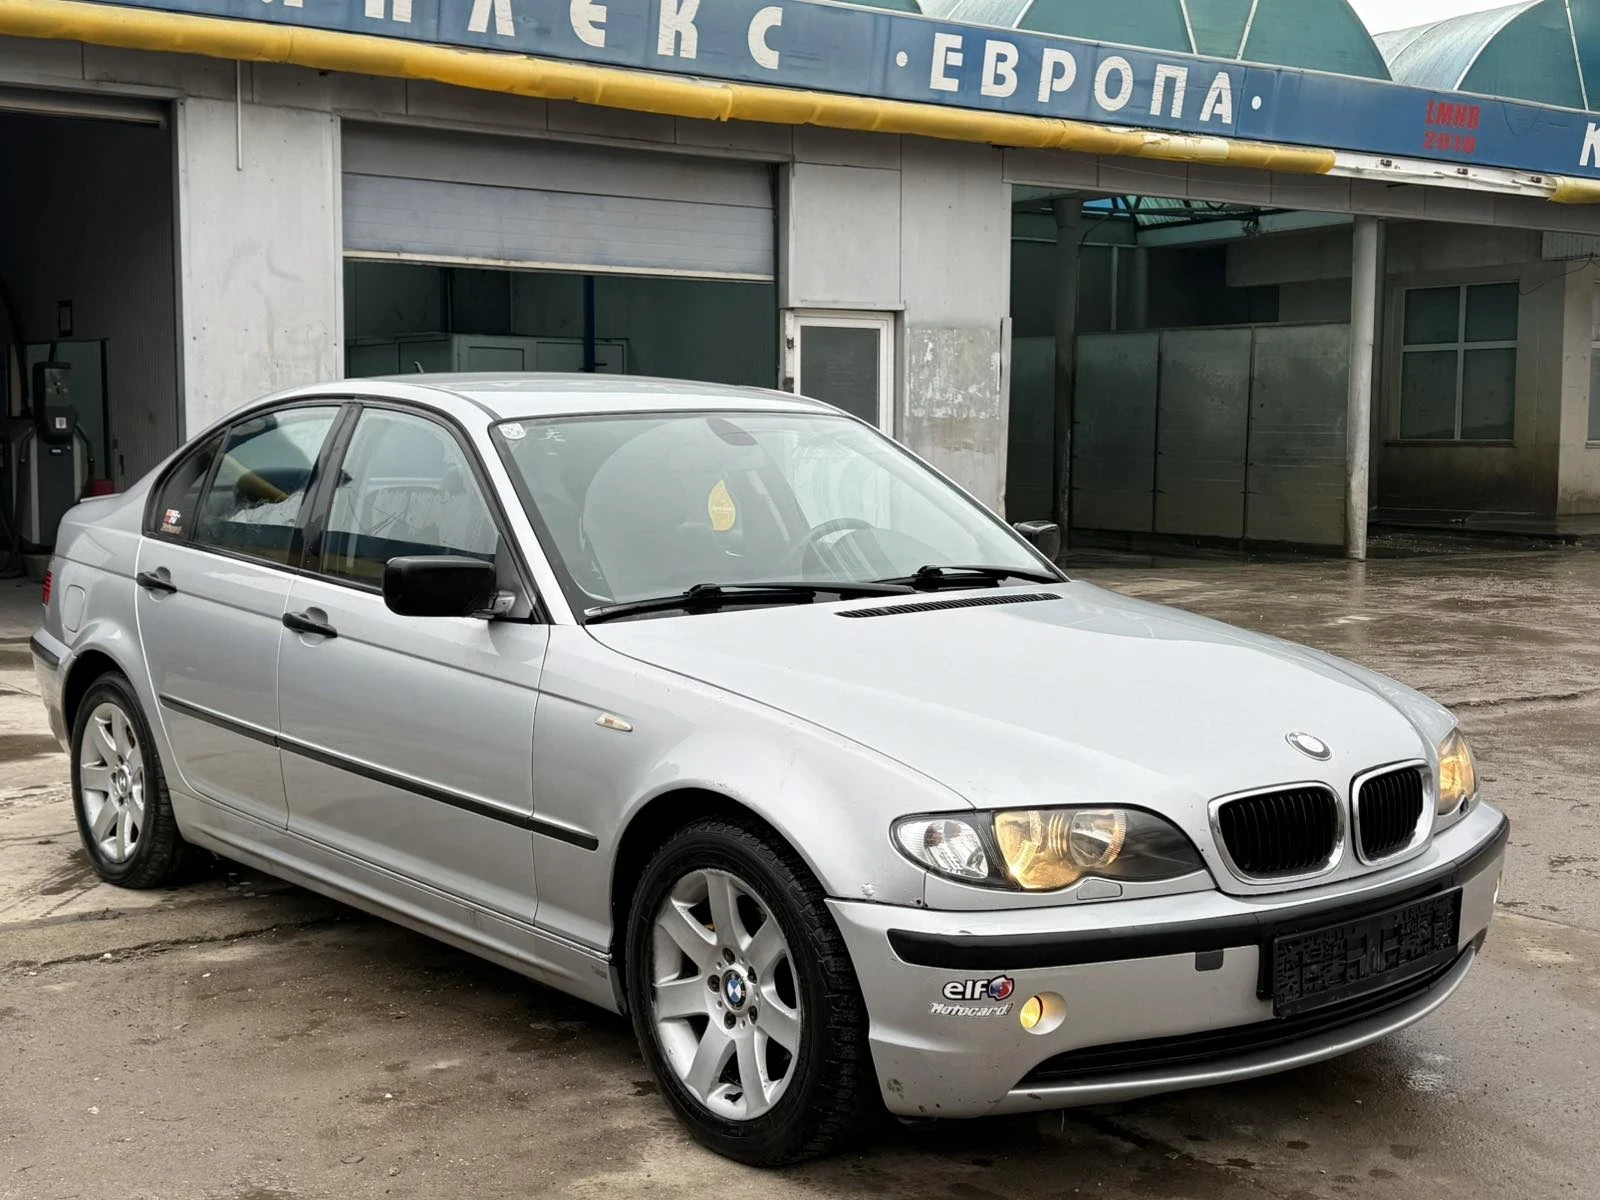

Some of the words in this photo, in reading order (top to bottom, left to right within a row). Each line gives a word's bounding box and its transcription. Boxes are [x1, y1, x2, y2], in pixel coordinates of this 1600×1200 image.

[261, 0, 784, 71] ЛЕКС
[929, 31, 1234, 125] ЕВРОПА
[942, 979, 990, 1001] elf
